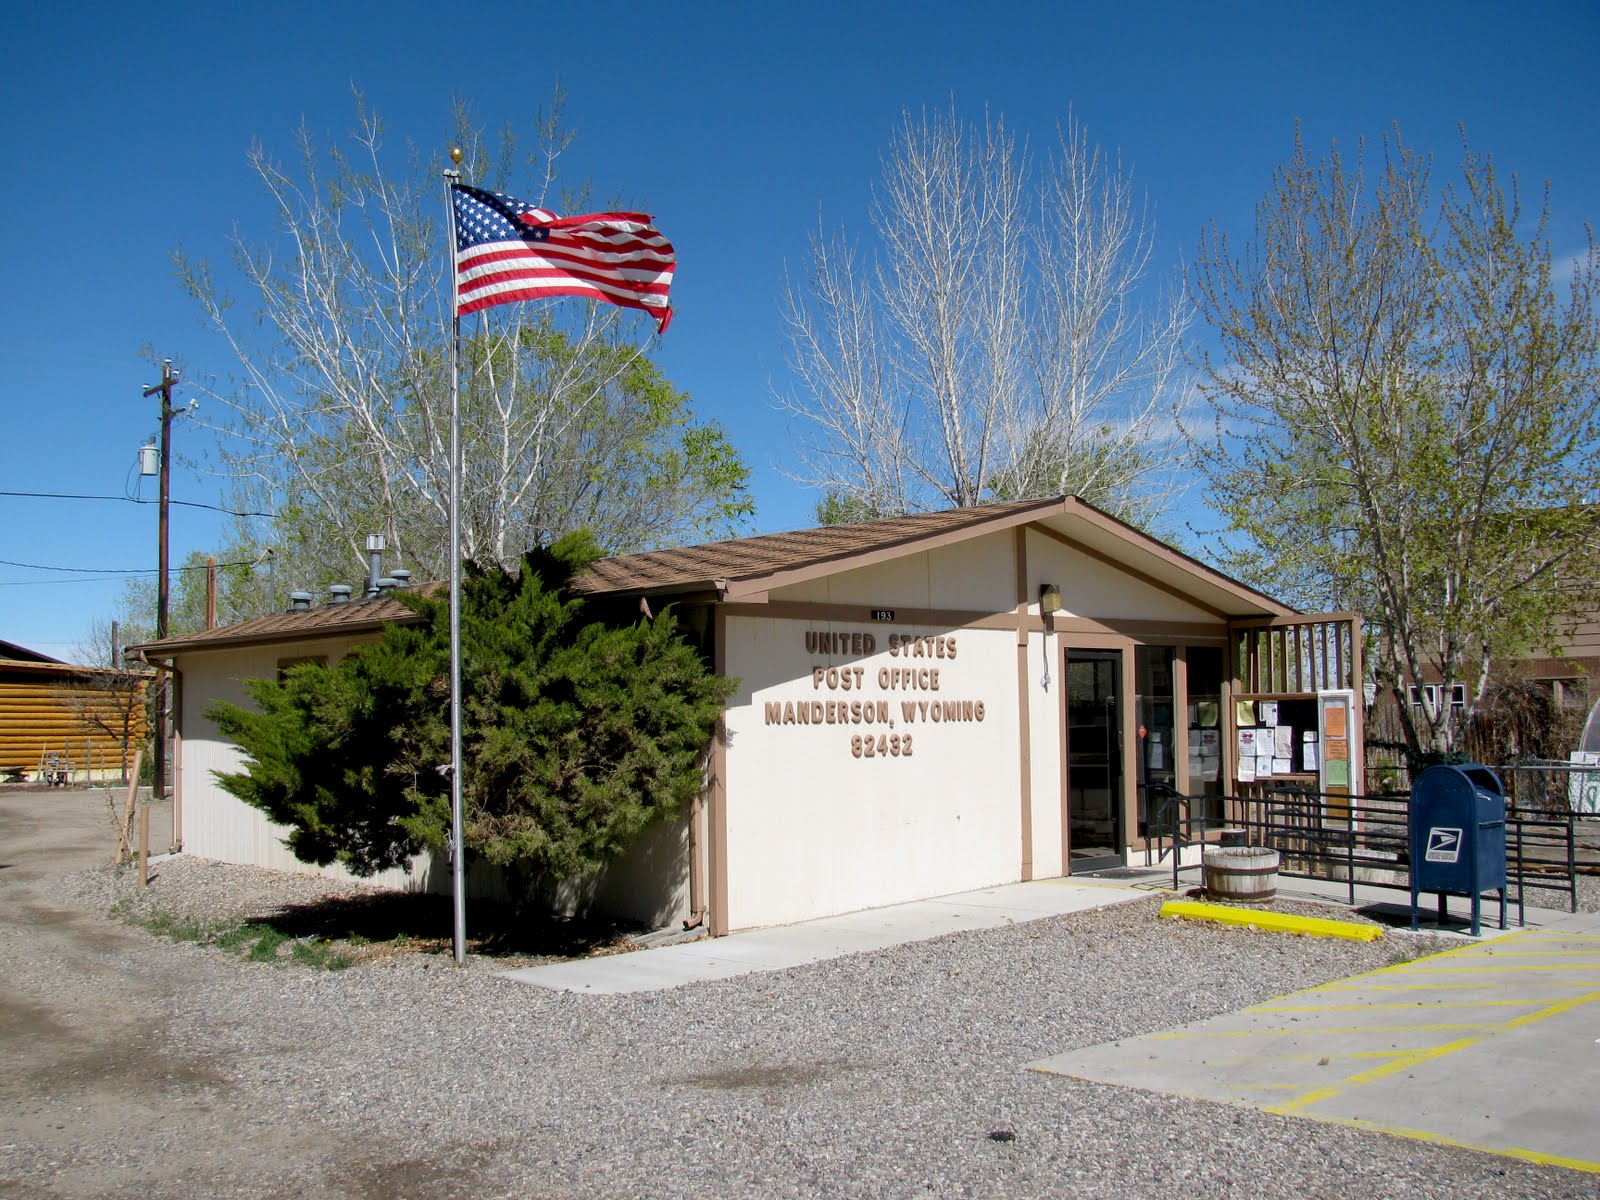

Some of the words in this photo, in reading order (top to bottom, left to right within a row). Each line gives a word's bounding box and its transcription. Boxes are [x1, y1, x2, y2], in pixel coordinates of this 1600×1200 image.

[876, 611, 892, 620] 193
[805, 631, 876, 655] UNITED
[889, 633, 957, 659] STATES
[813, 666, 865, 690] POST
[878, 667, 940, 691] OFFICE
[764, 701, 895, 729] MANDERSON,
[901, 700, 985, 723] WYOMING
[851, 734, 913, 758] 82432
